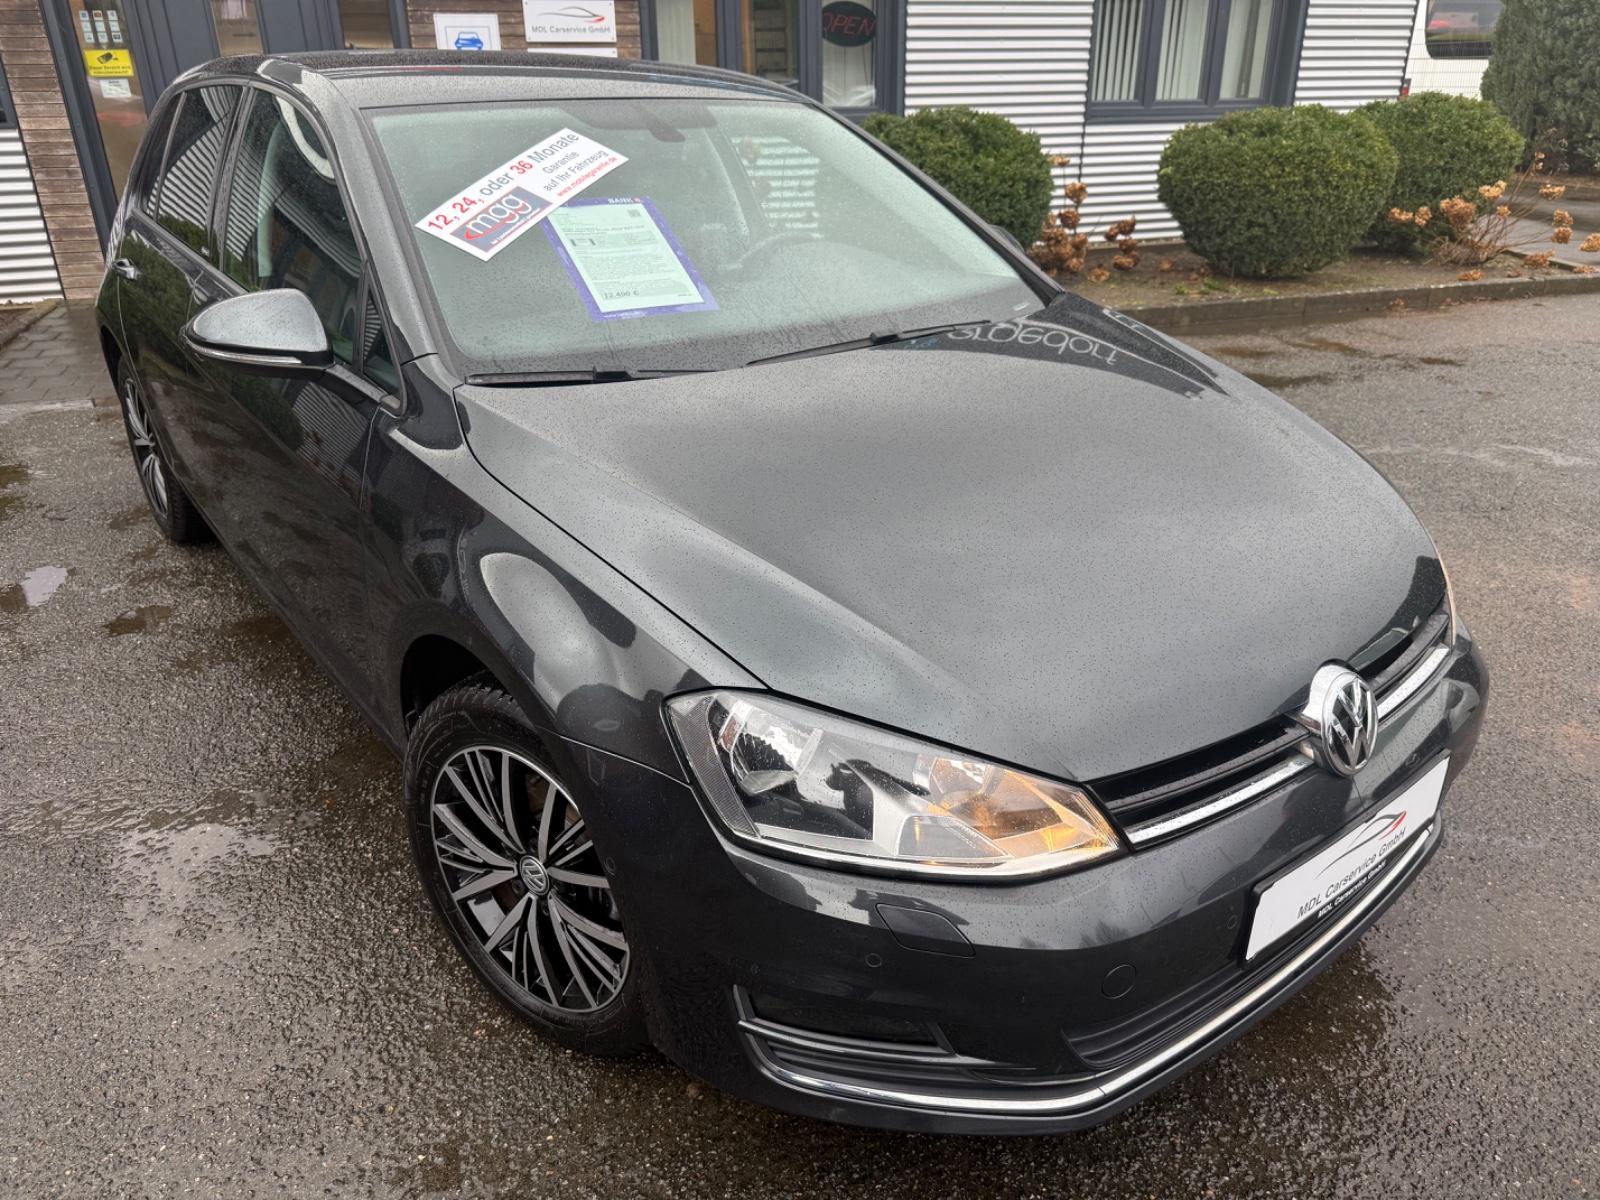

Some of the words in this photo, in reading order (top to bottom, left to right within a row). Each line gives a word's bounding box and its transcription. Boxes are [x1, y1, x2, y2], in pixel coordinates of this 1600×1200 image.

[823, 12, 876, 37] OPEN
[428, 214, 460, 230] 12,
[452, 196, 485, 214] 24,
[480, 172, 515, 196] oder
[510, 160, 533, 175] 36
[527, 133, 580, 163] Monate
[542, 151, 580, 174] Garantie
[543, 177, 560, 192] auf
[557, 170, 573, 182] Ihr
[568, 150, 610, 174] Fahrzeug
[1297, 893, 1322, 918] MDL
[1325, 854, 1377, 898] Carservice
[1378, 827, 1406, 856] GmbH
